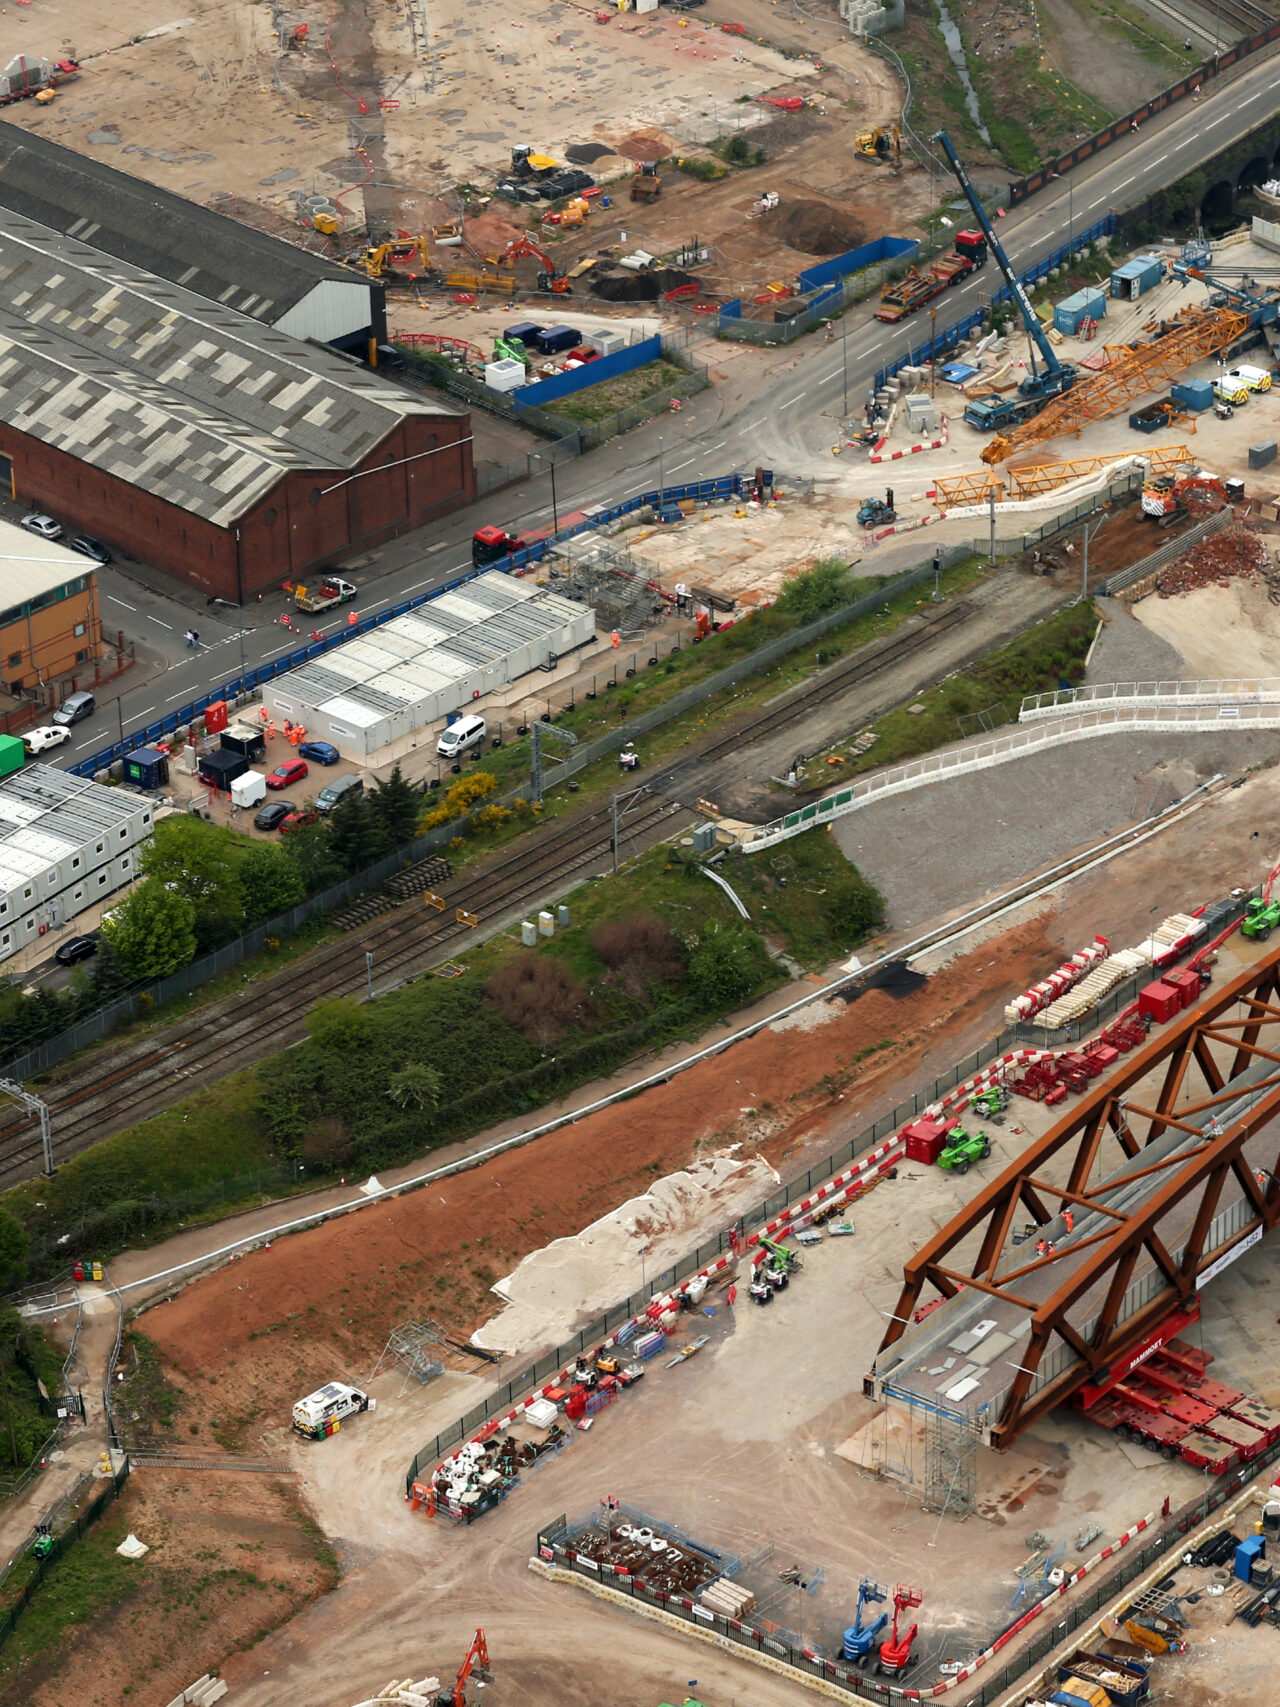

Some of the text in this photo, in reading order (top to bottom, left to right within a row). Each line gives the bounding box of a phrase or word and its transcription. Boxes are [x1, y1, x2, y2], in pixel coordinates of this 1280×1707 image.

[1016, 283, 1037, 321] sarens
[1246, 1232, 1259, 1246] HS2
[1130, 1337, 1163, 1369] MAMMOET
